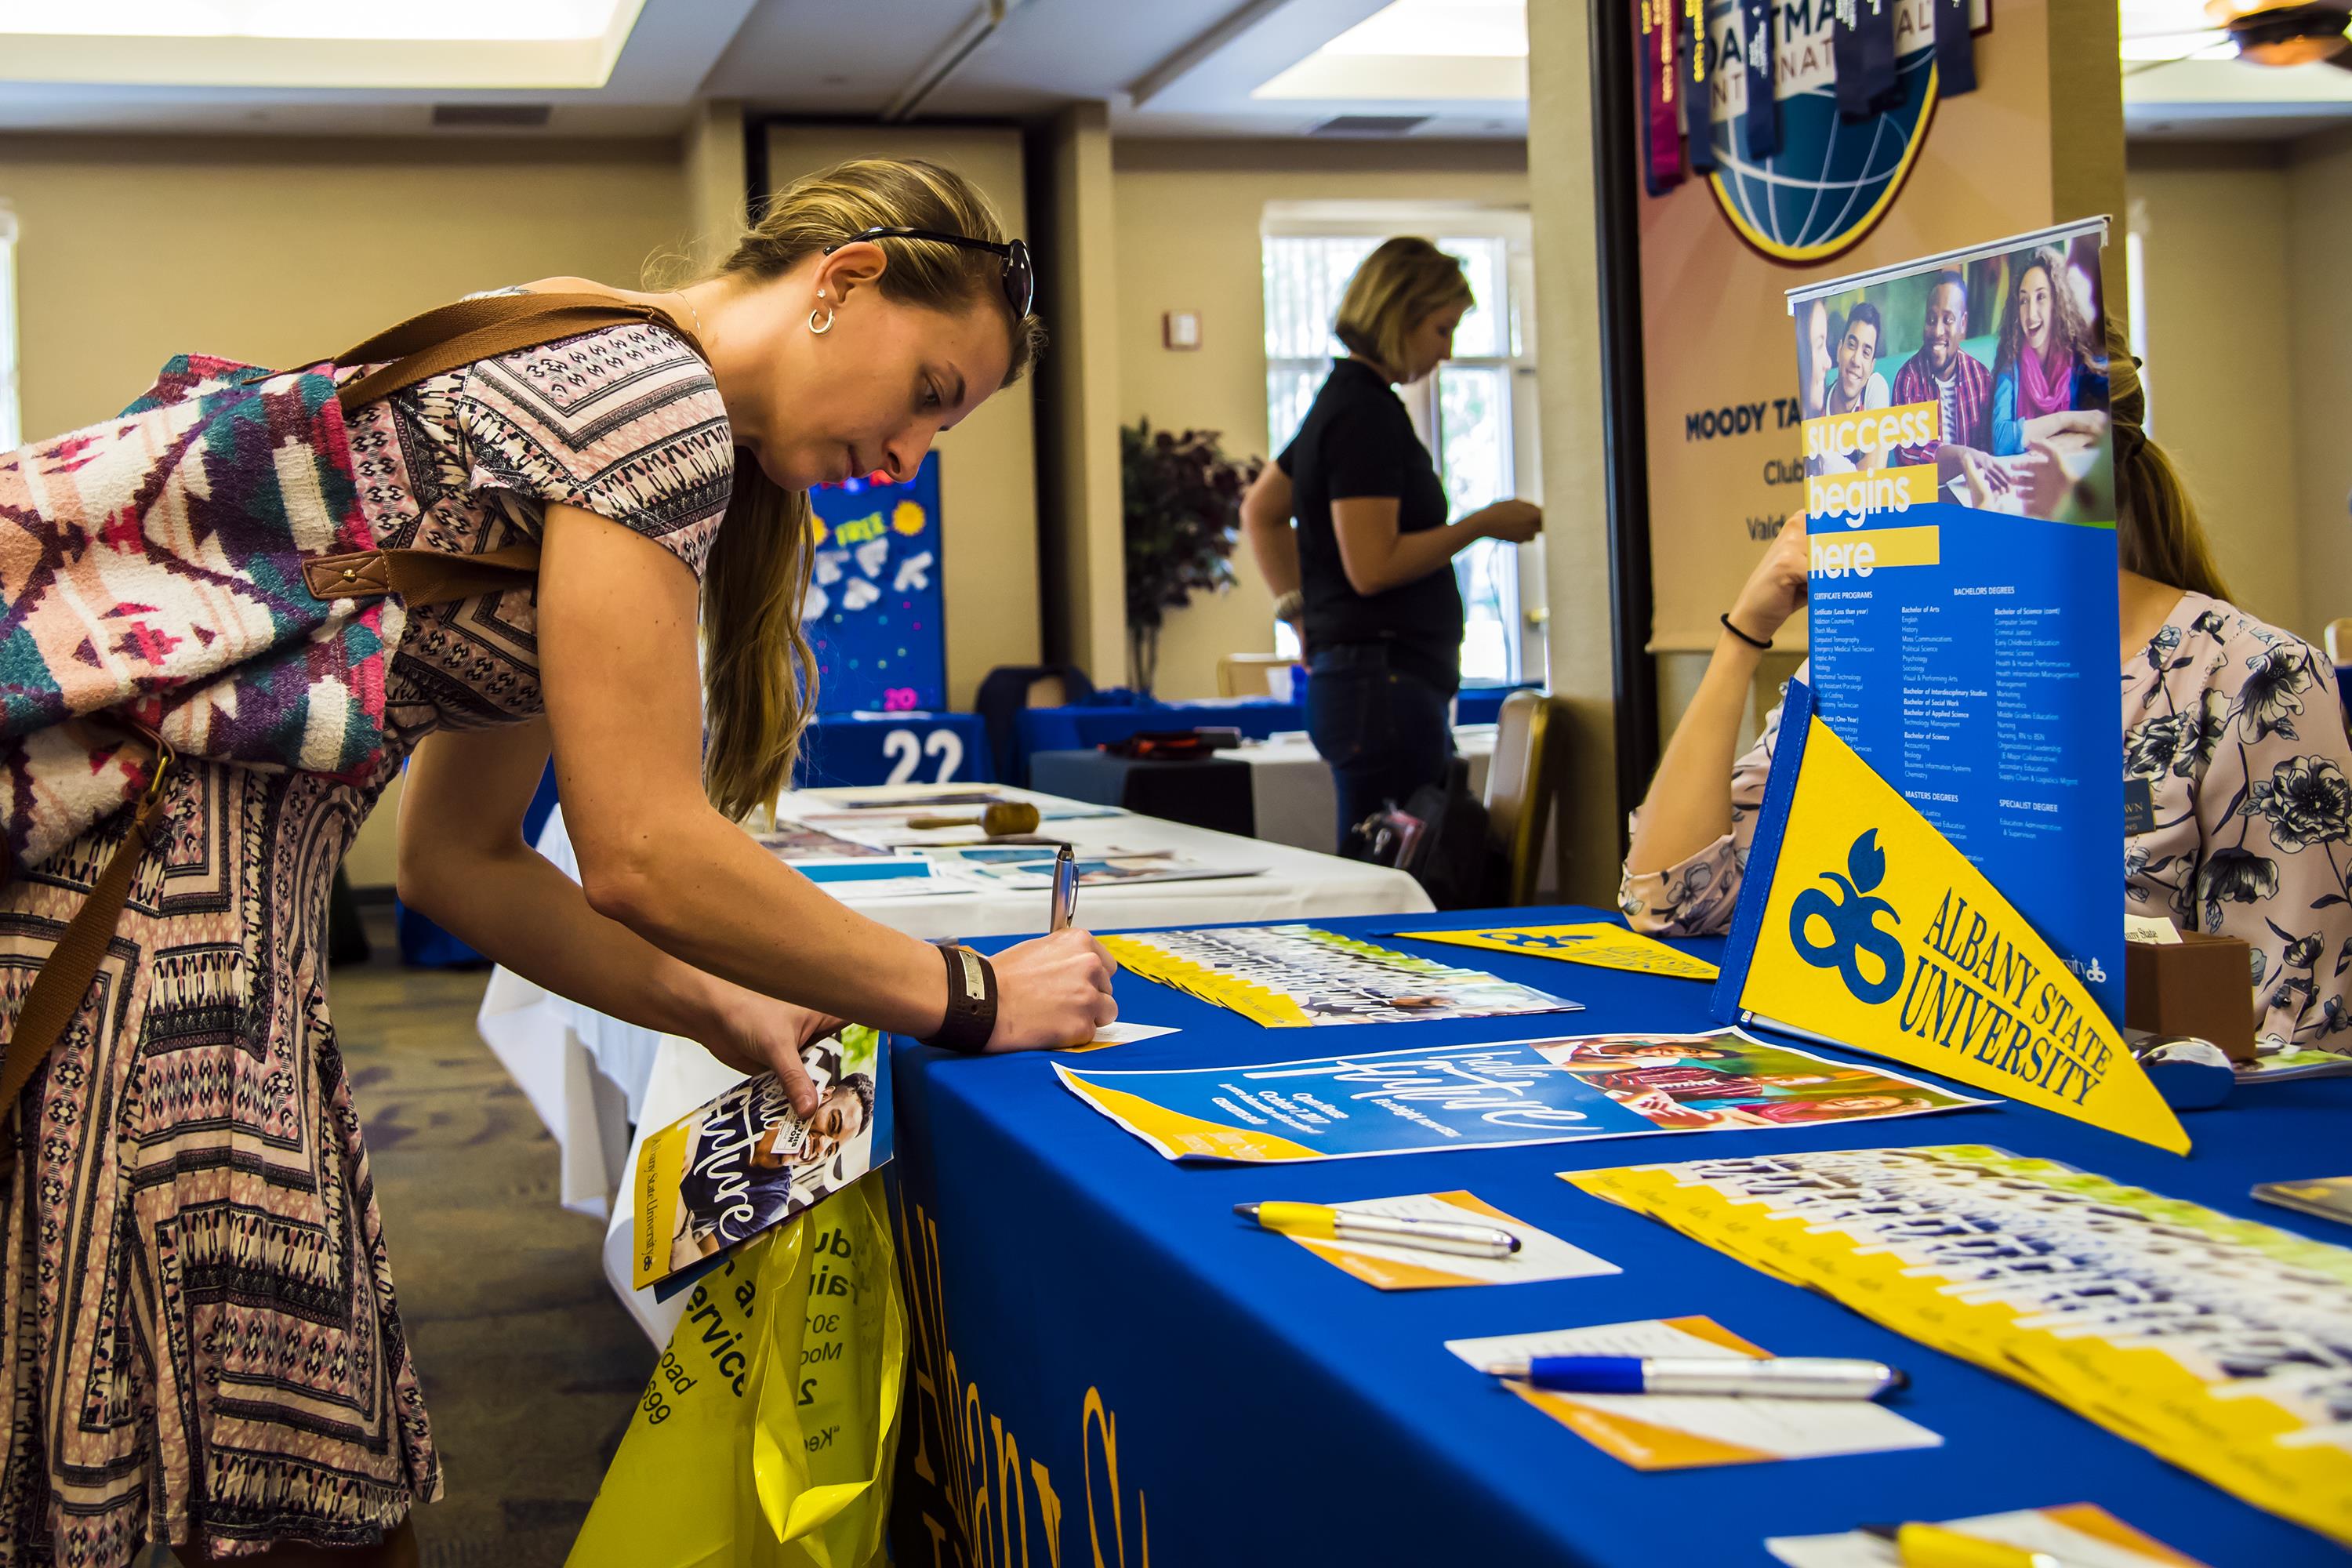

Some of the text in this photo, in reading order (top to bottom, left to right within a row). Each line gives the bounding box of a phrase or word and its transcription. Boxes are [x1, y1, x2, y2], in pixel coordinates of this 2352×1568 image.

[1686, 397, 1801, 443] MOODY TA
[1808, 410, 1930, 460] success
[1809, 467, 1911, 528] begins
[1746, 514, 1786, 540] Vald
[1810, 534, 1875, 579] here
[883, 728, 964, 785] 22
[1905, 791, 1958, 802] MASTERS DEGREES
[1999, 800, 2057, 812] SPECIALIST DEGREE
[1923, 887, 2113, 1076] ALBANY STATE
[1899, 955, 2100, 1106] UNIVERSITY
[1243, 1060, 1605, 1131] future
[788, 1119, 801, 1142] UPON
[791, 1127, 804, 1147] THIS
[677, 1087, 765, 1241] future
[641, 1138, 662, 1255] Albany State University
